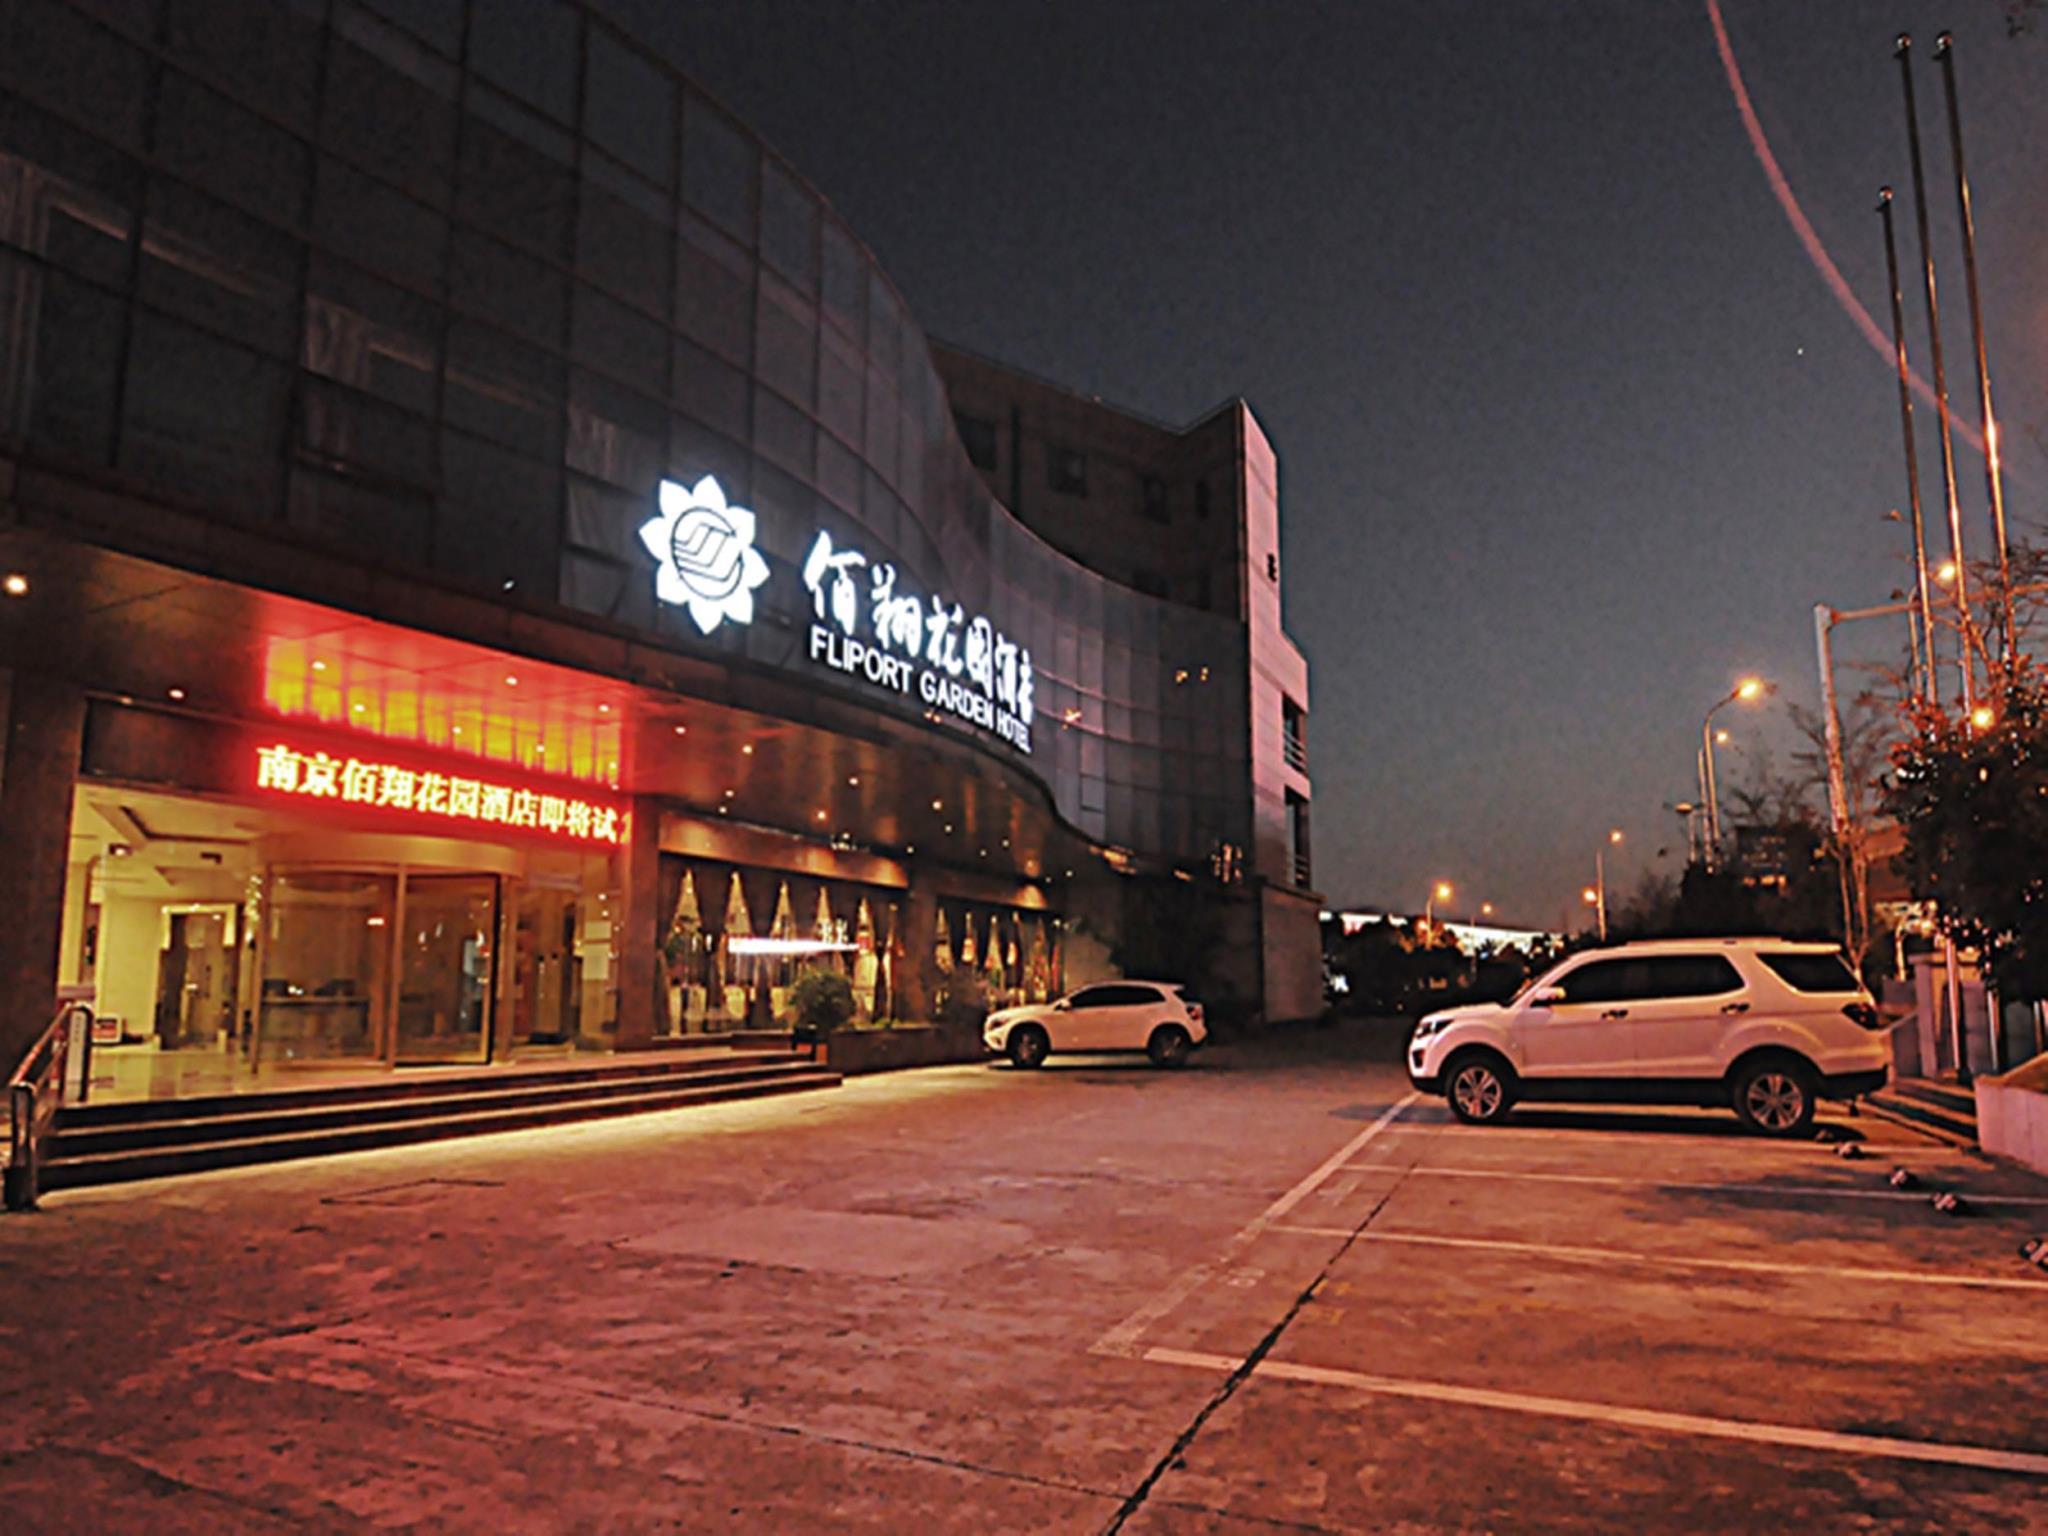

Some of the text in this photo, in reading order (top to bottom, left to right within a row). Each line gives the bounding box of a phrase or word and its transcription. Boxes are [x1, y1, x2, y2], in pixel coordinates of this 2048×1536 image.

[811, 626, 1031, 753] FLIPORT GARDEN HOTEL
